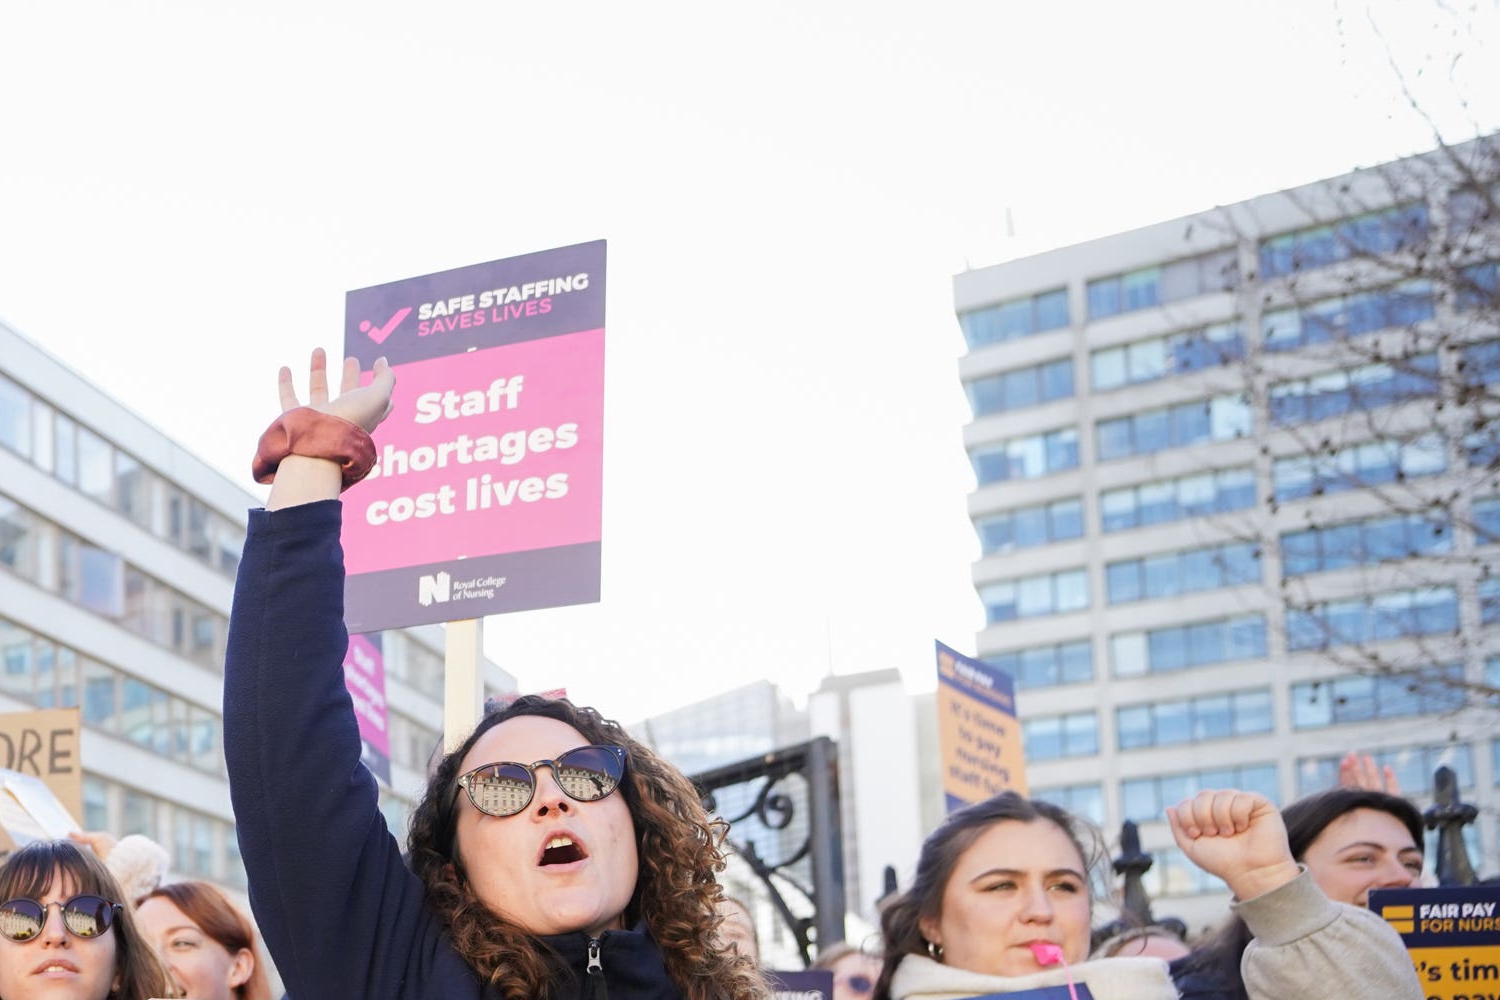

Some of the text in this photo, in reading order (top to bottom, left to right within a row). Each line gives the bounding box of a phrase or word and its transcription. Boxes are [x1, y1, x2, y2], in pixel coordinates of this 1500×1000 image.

[418, 272, 589, 321] SAFE STAFFING
[417, 298, 553, 337] SAVES LIVES
[414, 376, 524, 424] Staff
[366, 473, 569, 525] cost lives
[452, 588, 494, 601] of Nursing
[453, 576, 507, 591] Royal College
[1420, 902, 1496, 919] FAIR PAY
[1421, 918, 1454, 934] FOR
[1450, 957, 1500, 982] tim
